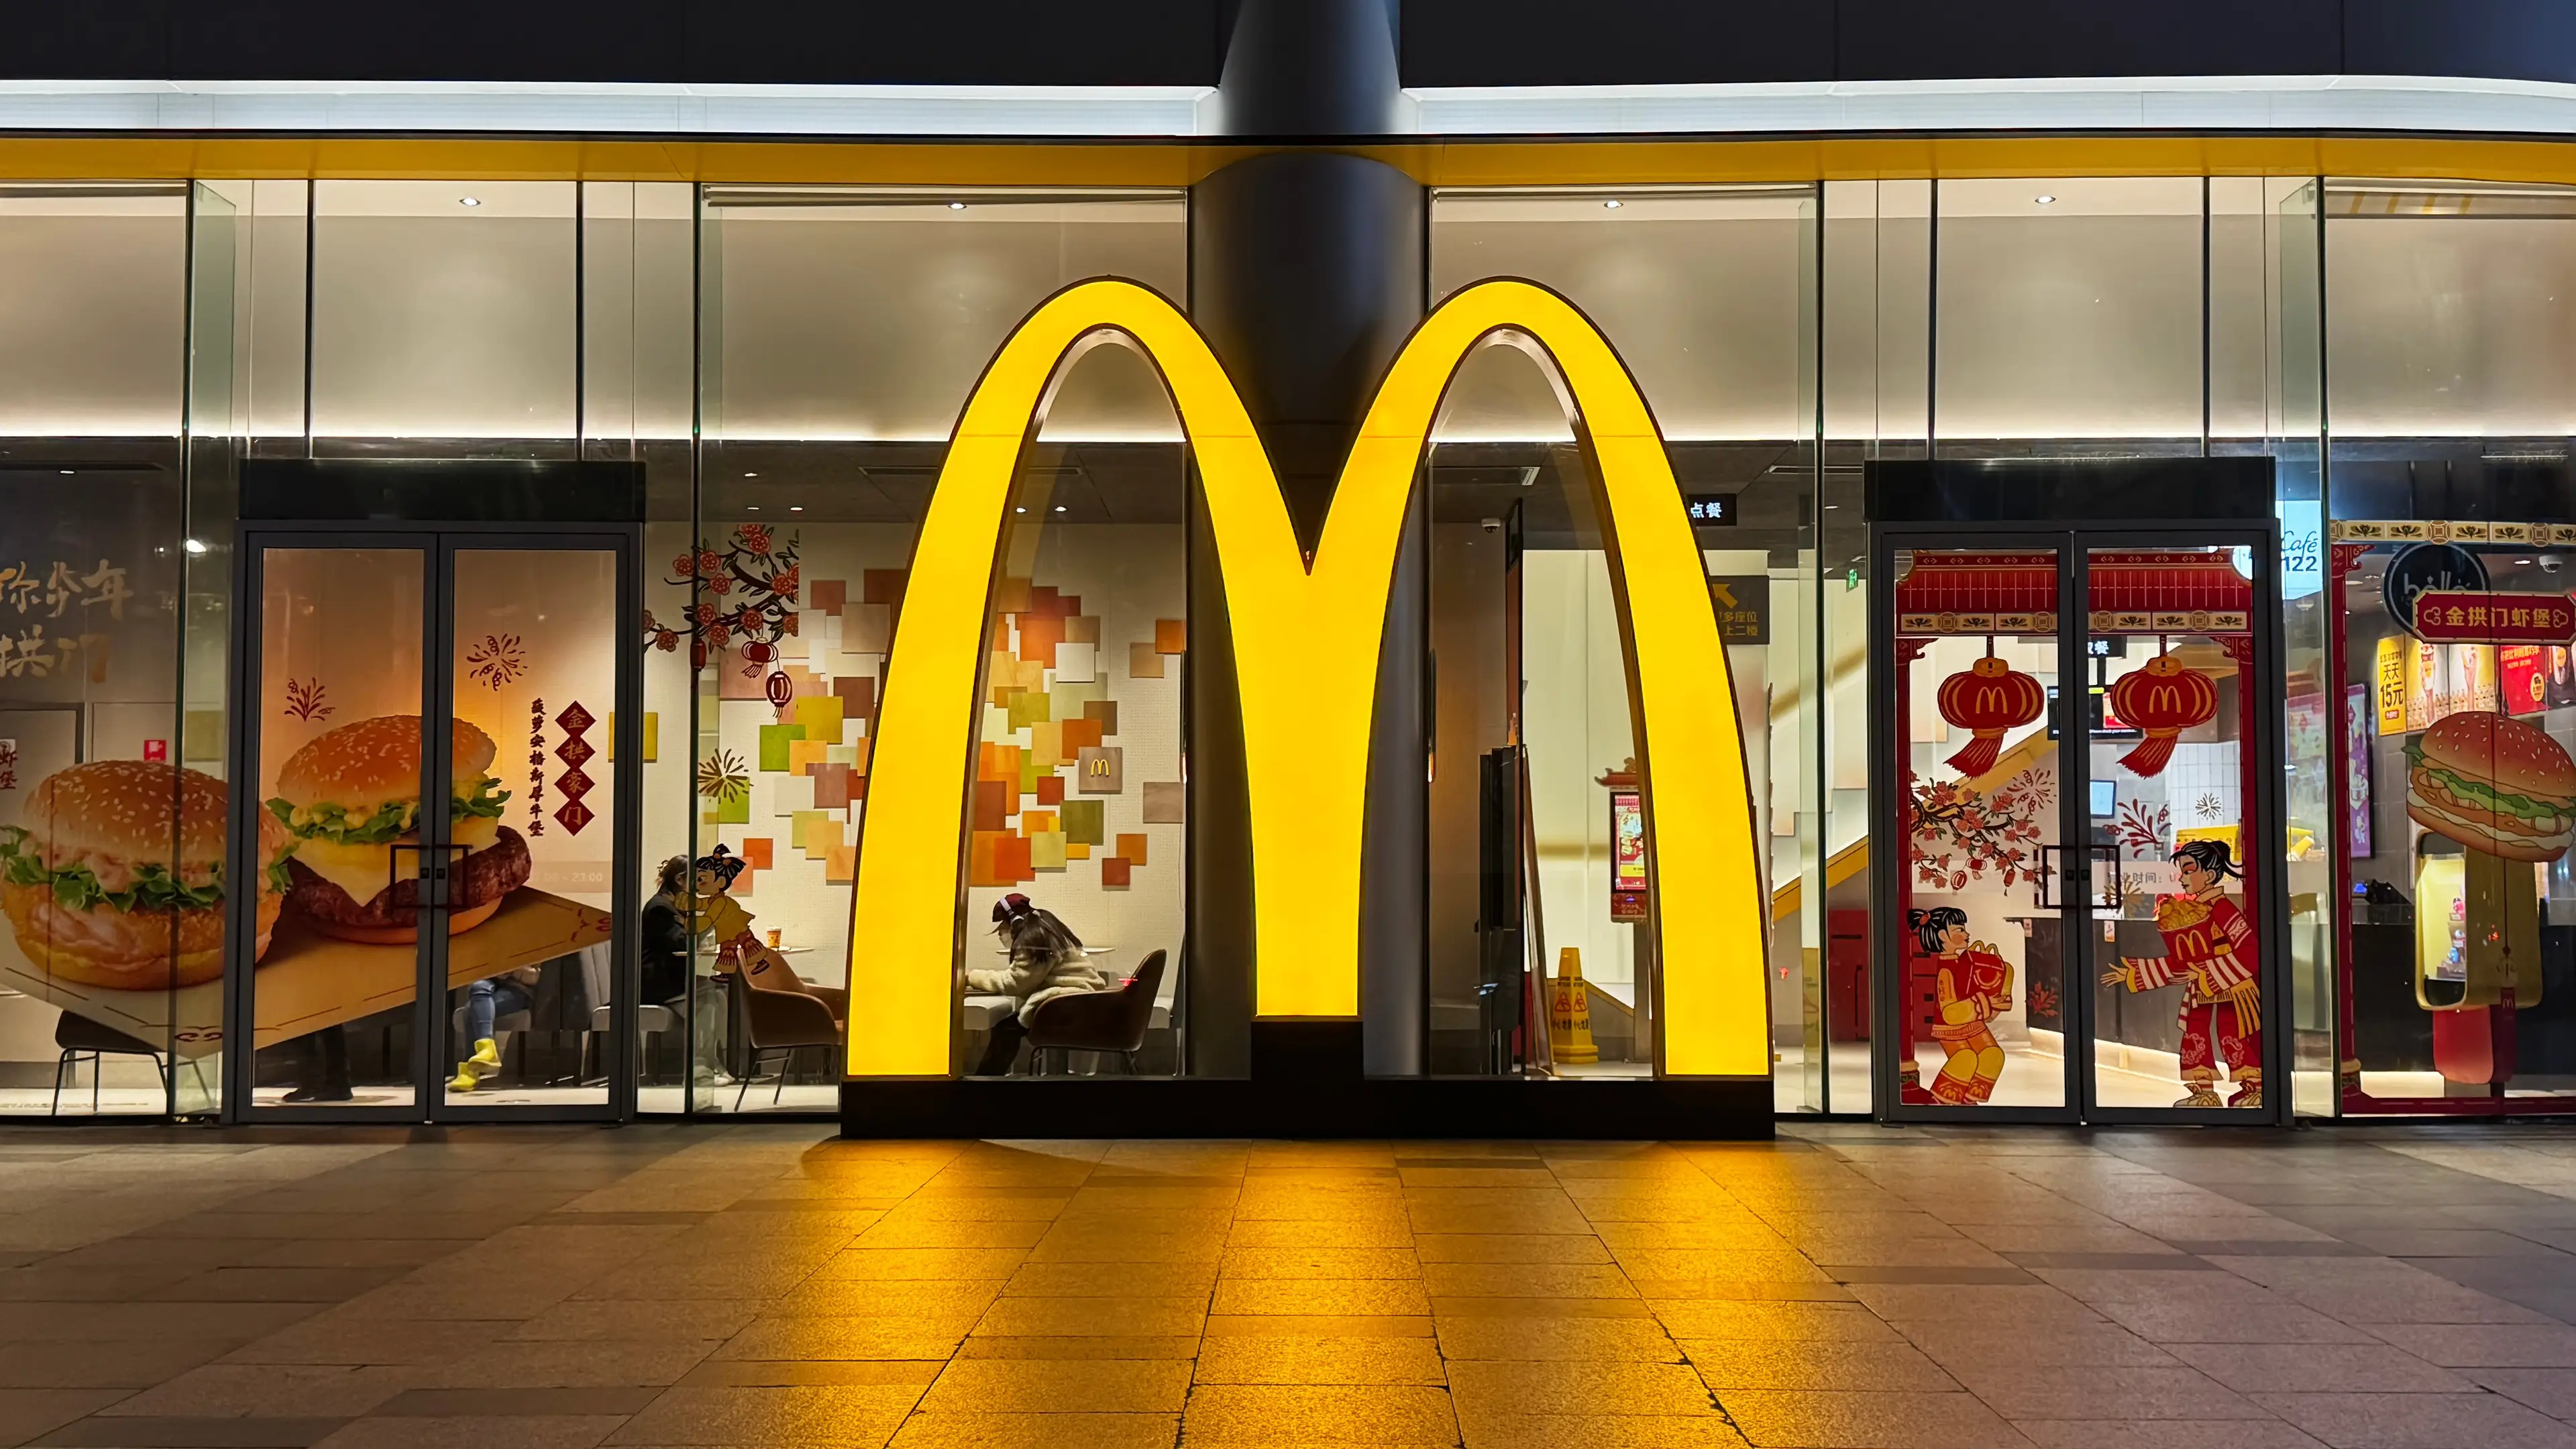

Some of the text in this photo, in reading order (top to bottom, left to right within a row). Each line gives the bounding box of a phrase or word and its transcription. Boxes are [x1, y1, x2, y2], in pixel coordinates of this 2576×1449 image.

[1690, 502, 1722, 518] 点餐
[2404, 571, 2467, 594] hll
[1719, 611, 1758, 623] 多座位
[2446, 606, 2551, 628] 金拱门虾堡
[2383, 662, 2400, 682] 天天
[2380, 681, 2404, 708] 15元
